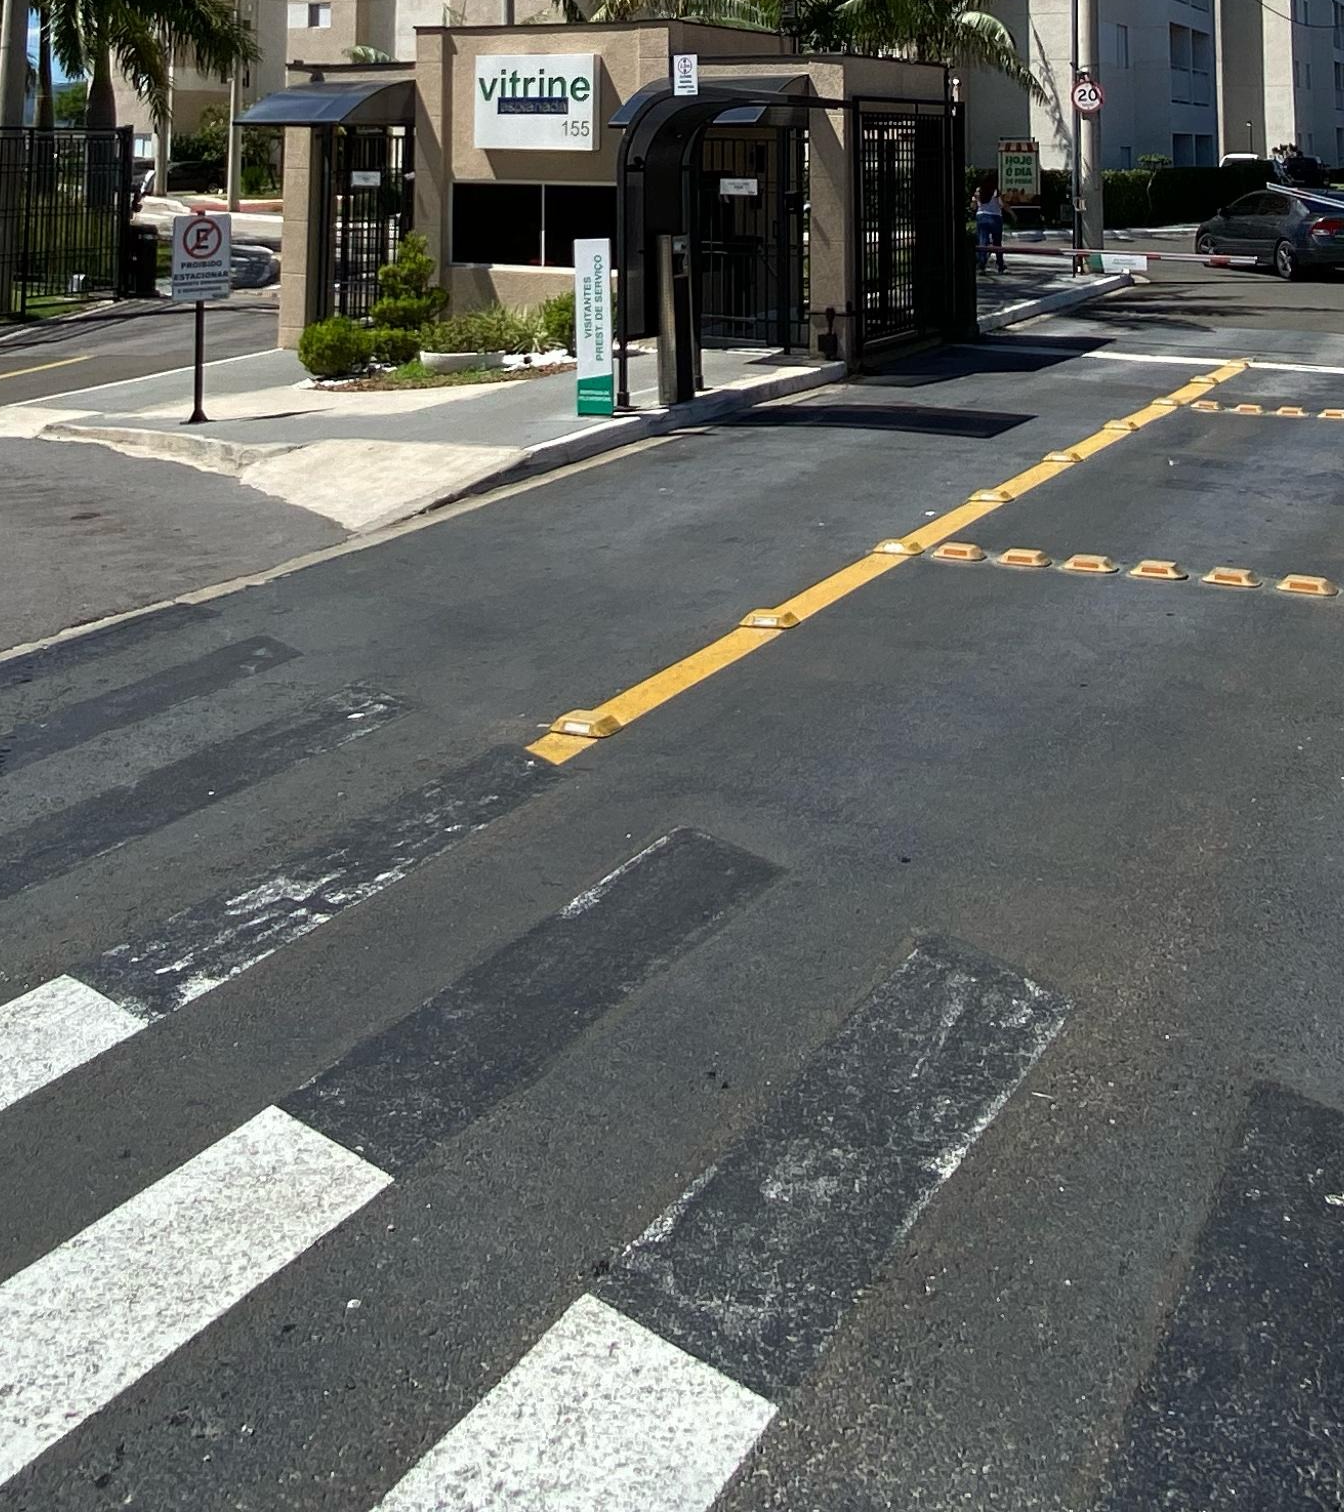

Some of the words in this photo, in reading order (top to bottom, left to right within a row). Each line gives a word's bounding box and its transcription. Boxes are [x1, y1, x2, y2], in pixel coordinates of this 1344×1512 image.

[479, 68, 591, 102] vitrine
[1078, 88, 1098, 102] 20
[562, 120, 590, 137] 155
[181, 260, 223, 269] PROIBIDO
[173, 270, 229, 280] ESTACIONAR
[593, 254, 603, 303] SERVIÇO
[583, 276, 592, 339] VISITANTES
[594, 306, 603, 321] DE
